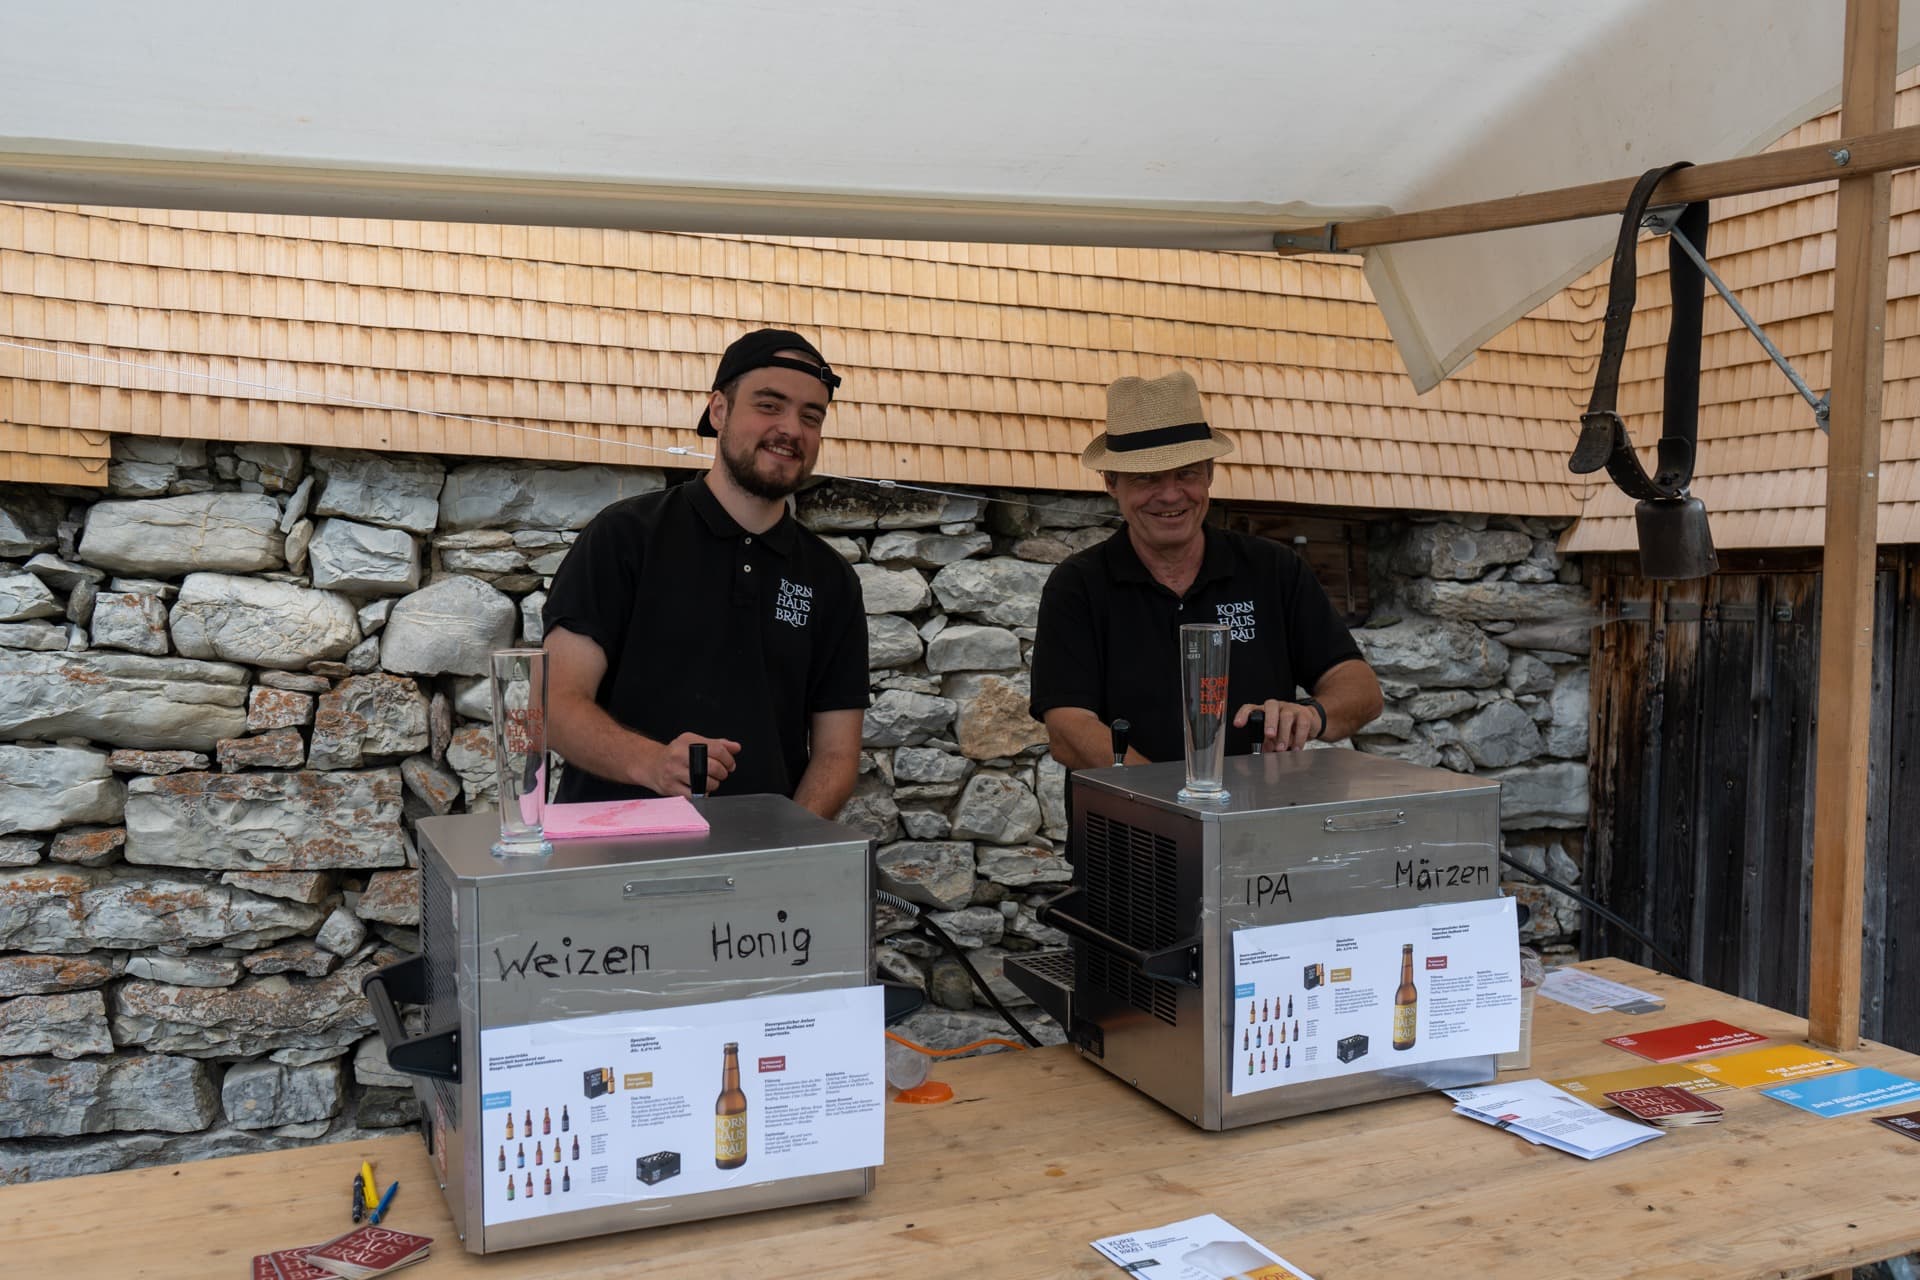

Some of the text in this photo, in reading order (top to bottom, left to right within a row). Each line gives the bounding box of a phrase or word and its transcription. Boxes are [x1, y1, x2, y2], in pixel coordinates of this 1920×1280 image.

[780, 578, 813, 598] KORN
[776, 593, 811, 612] HAUS
[1216, 601, 1254, 616] KORN
[775, 607, 808, 628] BRÄU
[1230, 627, 1256, 642] RÄU
[1395, 859, 1489, 890] Märzen
[1246, 873, 1292, 907] IPA
[711, 910, 812, 966] Honig
[494, 936, 650, 981] Weizen
[1637, 1102, 1687, 1116] BRÄU
[341, 1236, 403, 1255] HAUS
[358, 1227, 424, 1247] KORN
[326, 1245, 385, 1264] BRÄU
